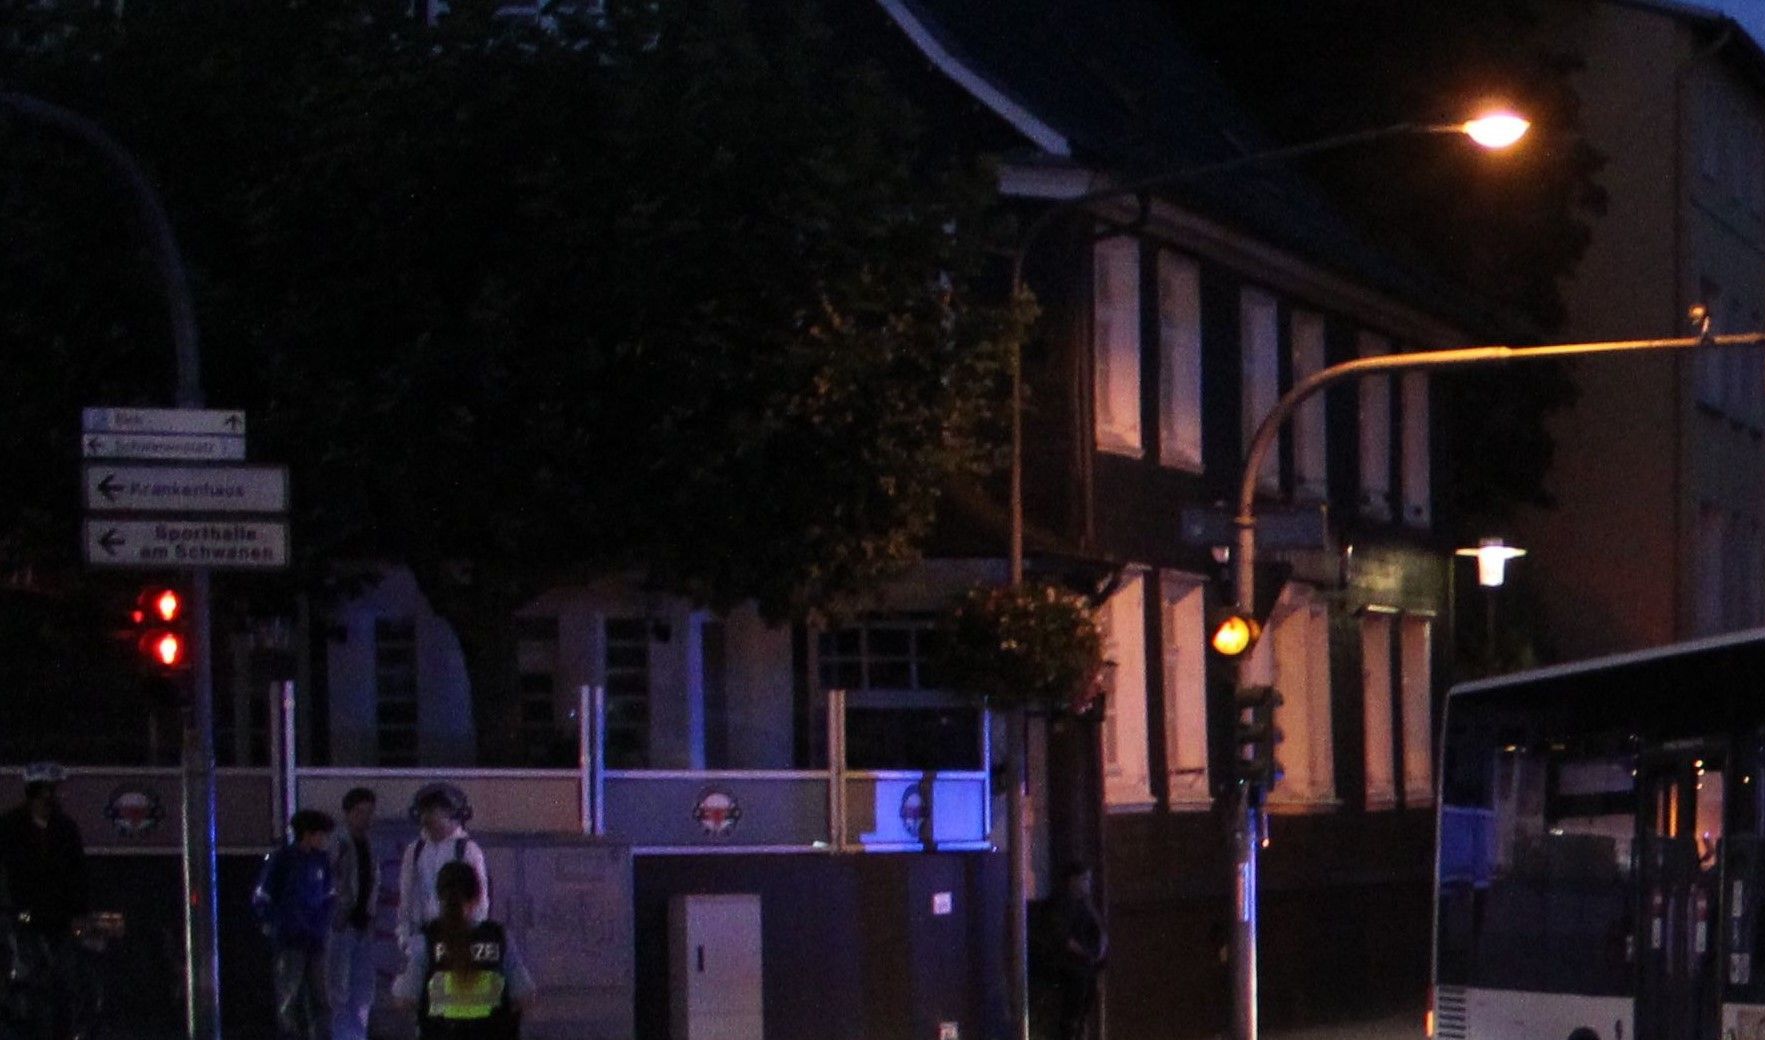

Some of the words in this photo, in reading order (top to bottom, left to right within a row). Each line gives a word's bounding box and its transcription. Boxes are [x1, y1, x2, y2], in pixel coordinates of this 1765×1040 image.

[155, 524, 257, 542] Sporthalle
[140, 547, 168, 560] am
[433, 941, 500, 962] PZEI
